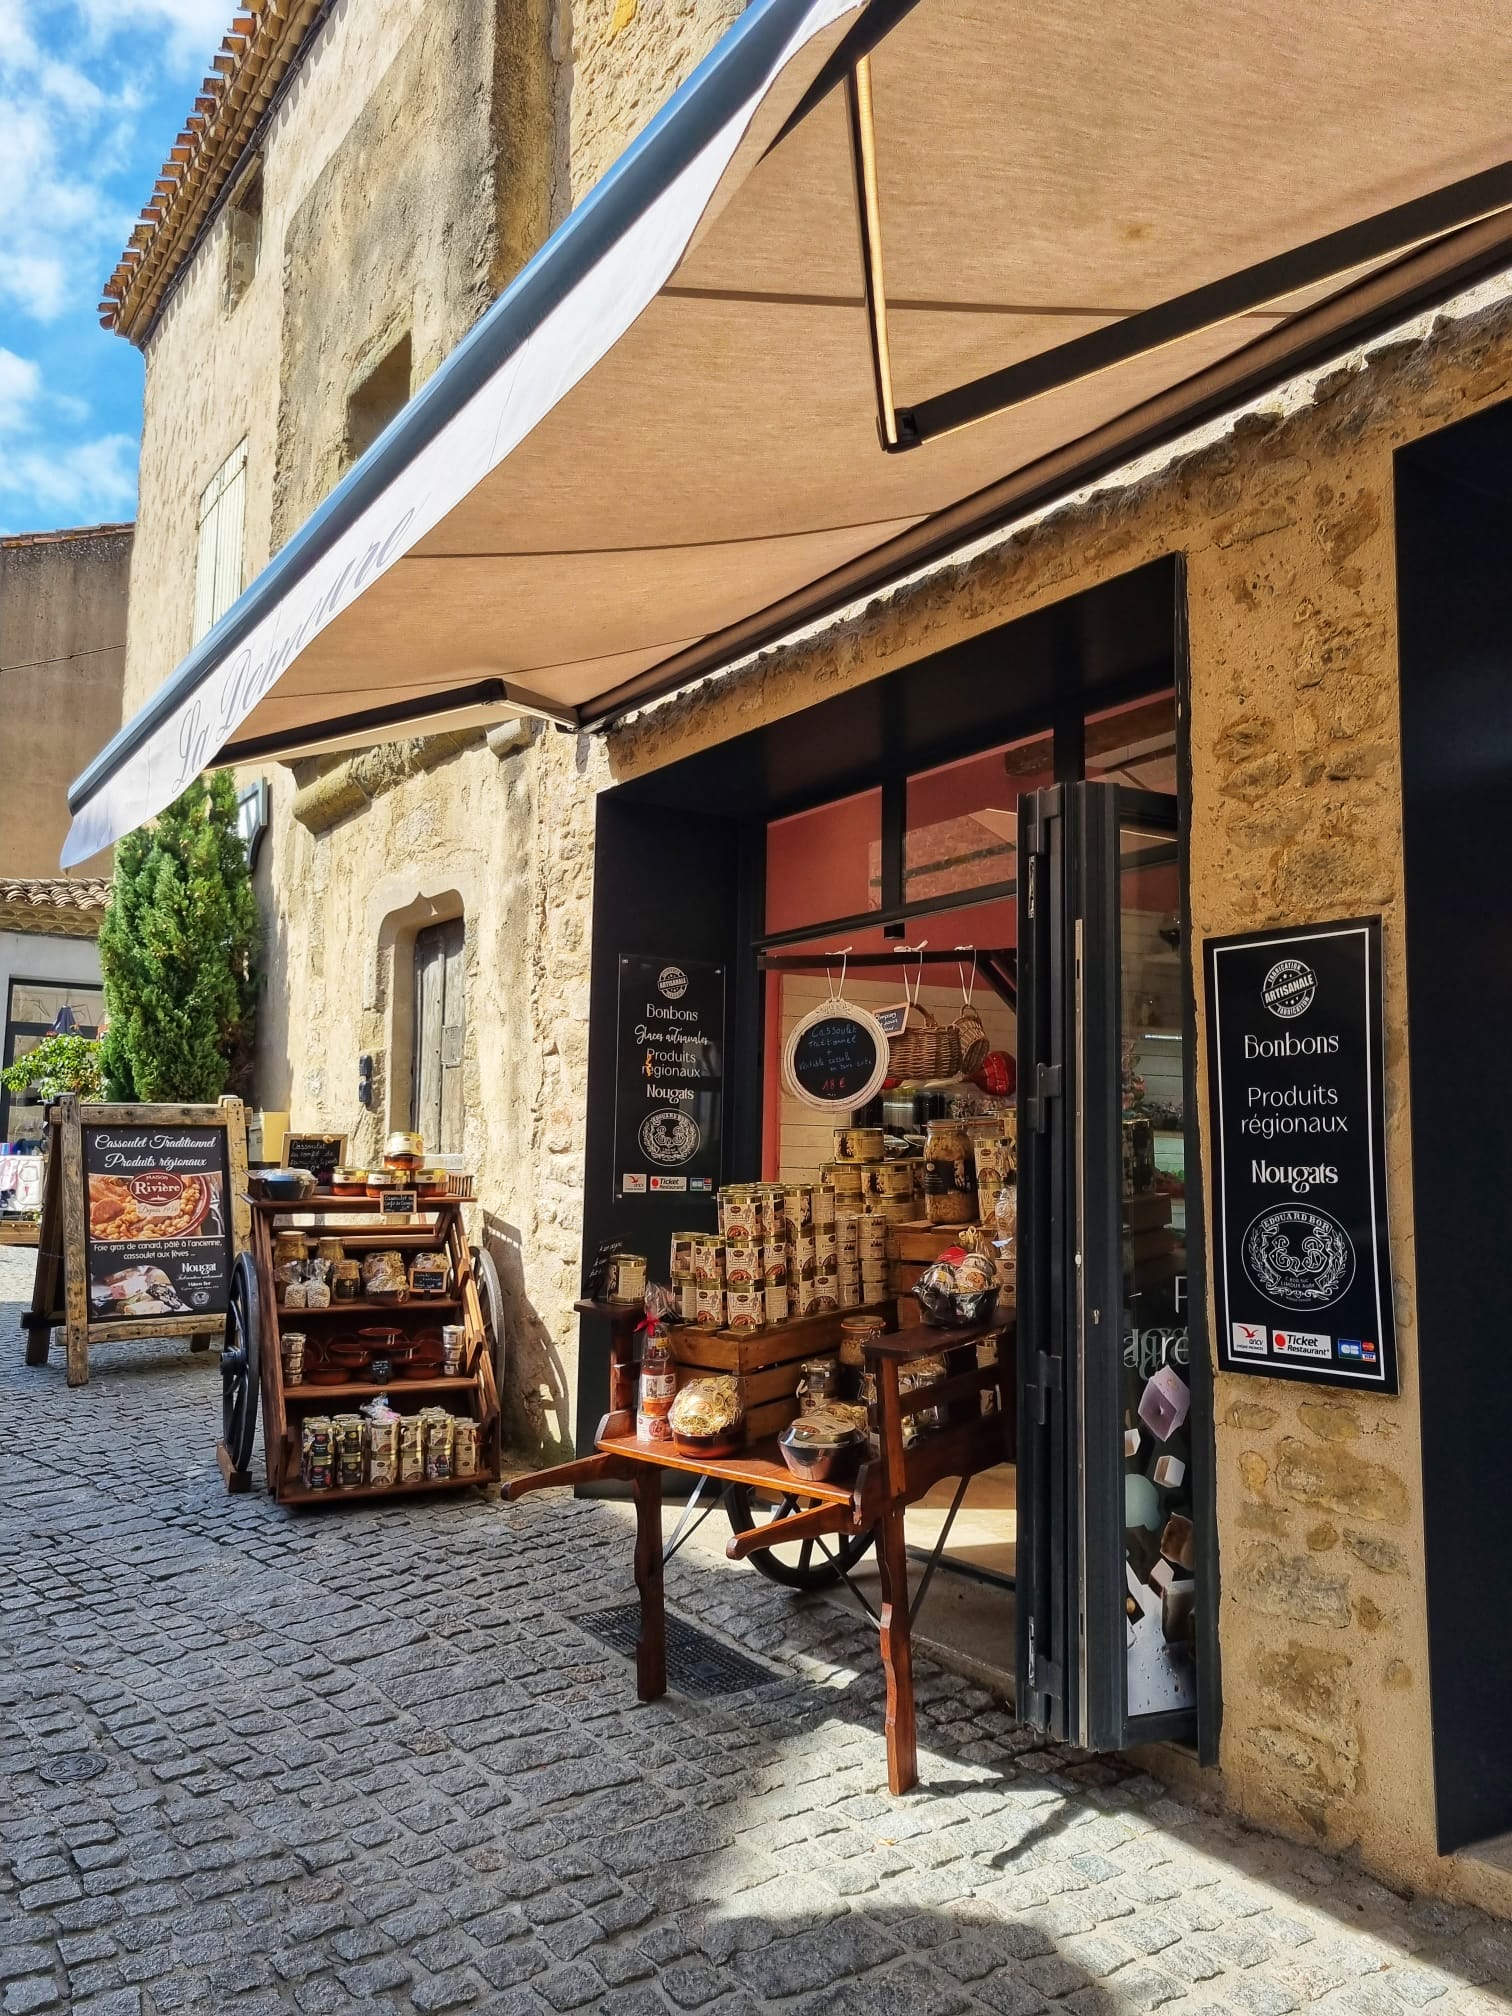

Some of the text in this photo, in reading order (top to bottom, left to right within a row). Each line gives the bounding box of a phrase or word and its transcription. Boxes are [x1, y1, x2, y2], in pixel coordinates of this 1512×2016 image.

[1264, 974, 1314, 1004] ARTISANALE
[646, 1003, 699, 1021] Bonbons
[634, 1024, 664, 1045] Glaces
[811, 1023, 857, 1038] Cassoulet
[1244, 1031, 1339, 1059] Bonbons
[647, 1048, 697, 1064] Produits
[646, 1083, 695, 1104] Nougats
[1248, 1083, 1338, 1108] Produits
[1241, 1112, 1348, 1140] régionaux
[95, 1134, 216, 1150] Cassoulet Traditionnel
[104, 1152, 207, 1171] Produits régionaux
[660, 1177, 680, 1185] Ticket
[1251, 1159, 1339, 1194] Nougats
[135, 1181, 180, 1195] Rivière
[1263, 1211, 1330, 1233] EDOUARD BOR
[94, 1243, 108, 1252] Foie
[109, 1243, 125, 1253] gras
[127, 1241, 136, 1250] de
[138, 1240, 163, 1250] canard,
[164, 1239, 180, 1249] pâté
[182, 1239, 187, 1248] à
[123, 1249, 156, 1260] cassoulet
[157, 1250, 170, 1259] aux
[181, 1262, 217, 1275] Nougat
[1287, 1334, 1318, 1347] Ticket
